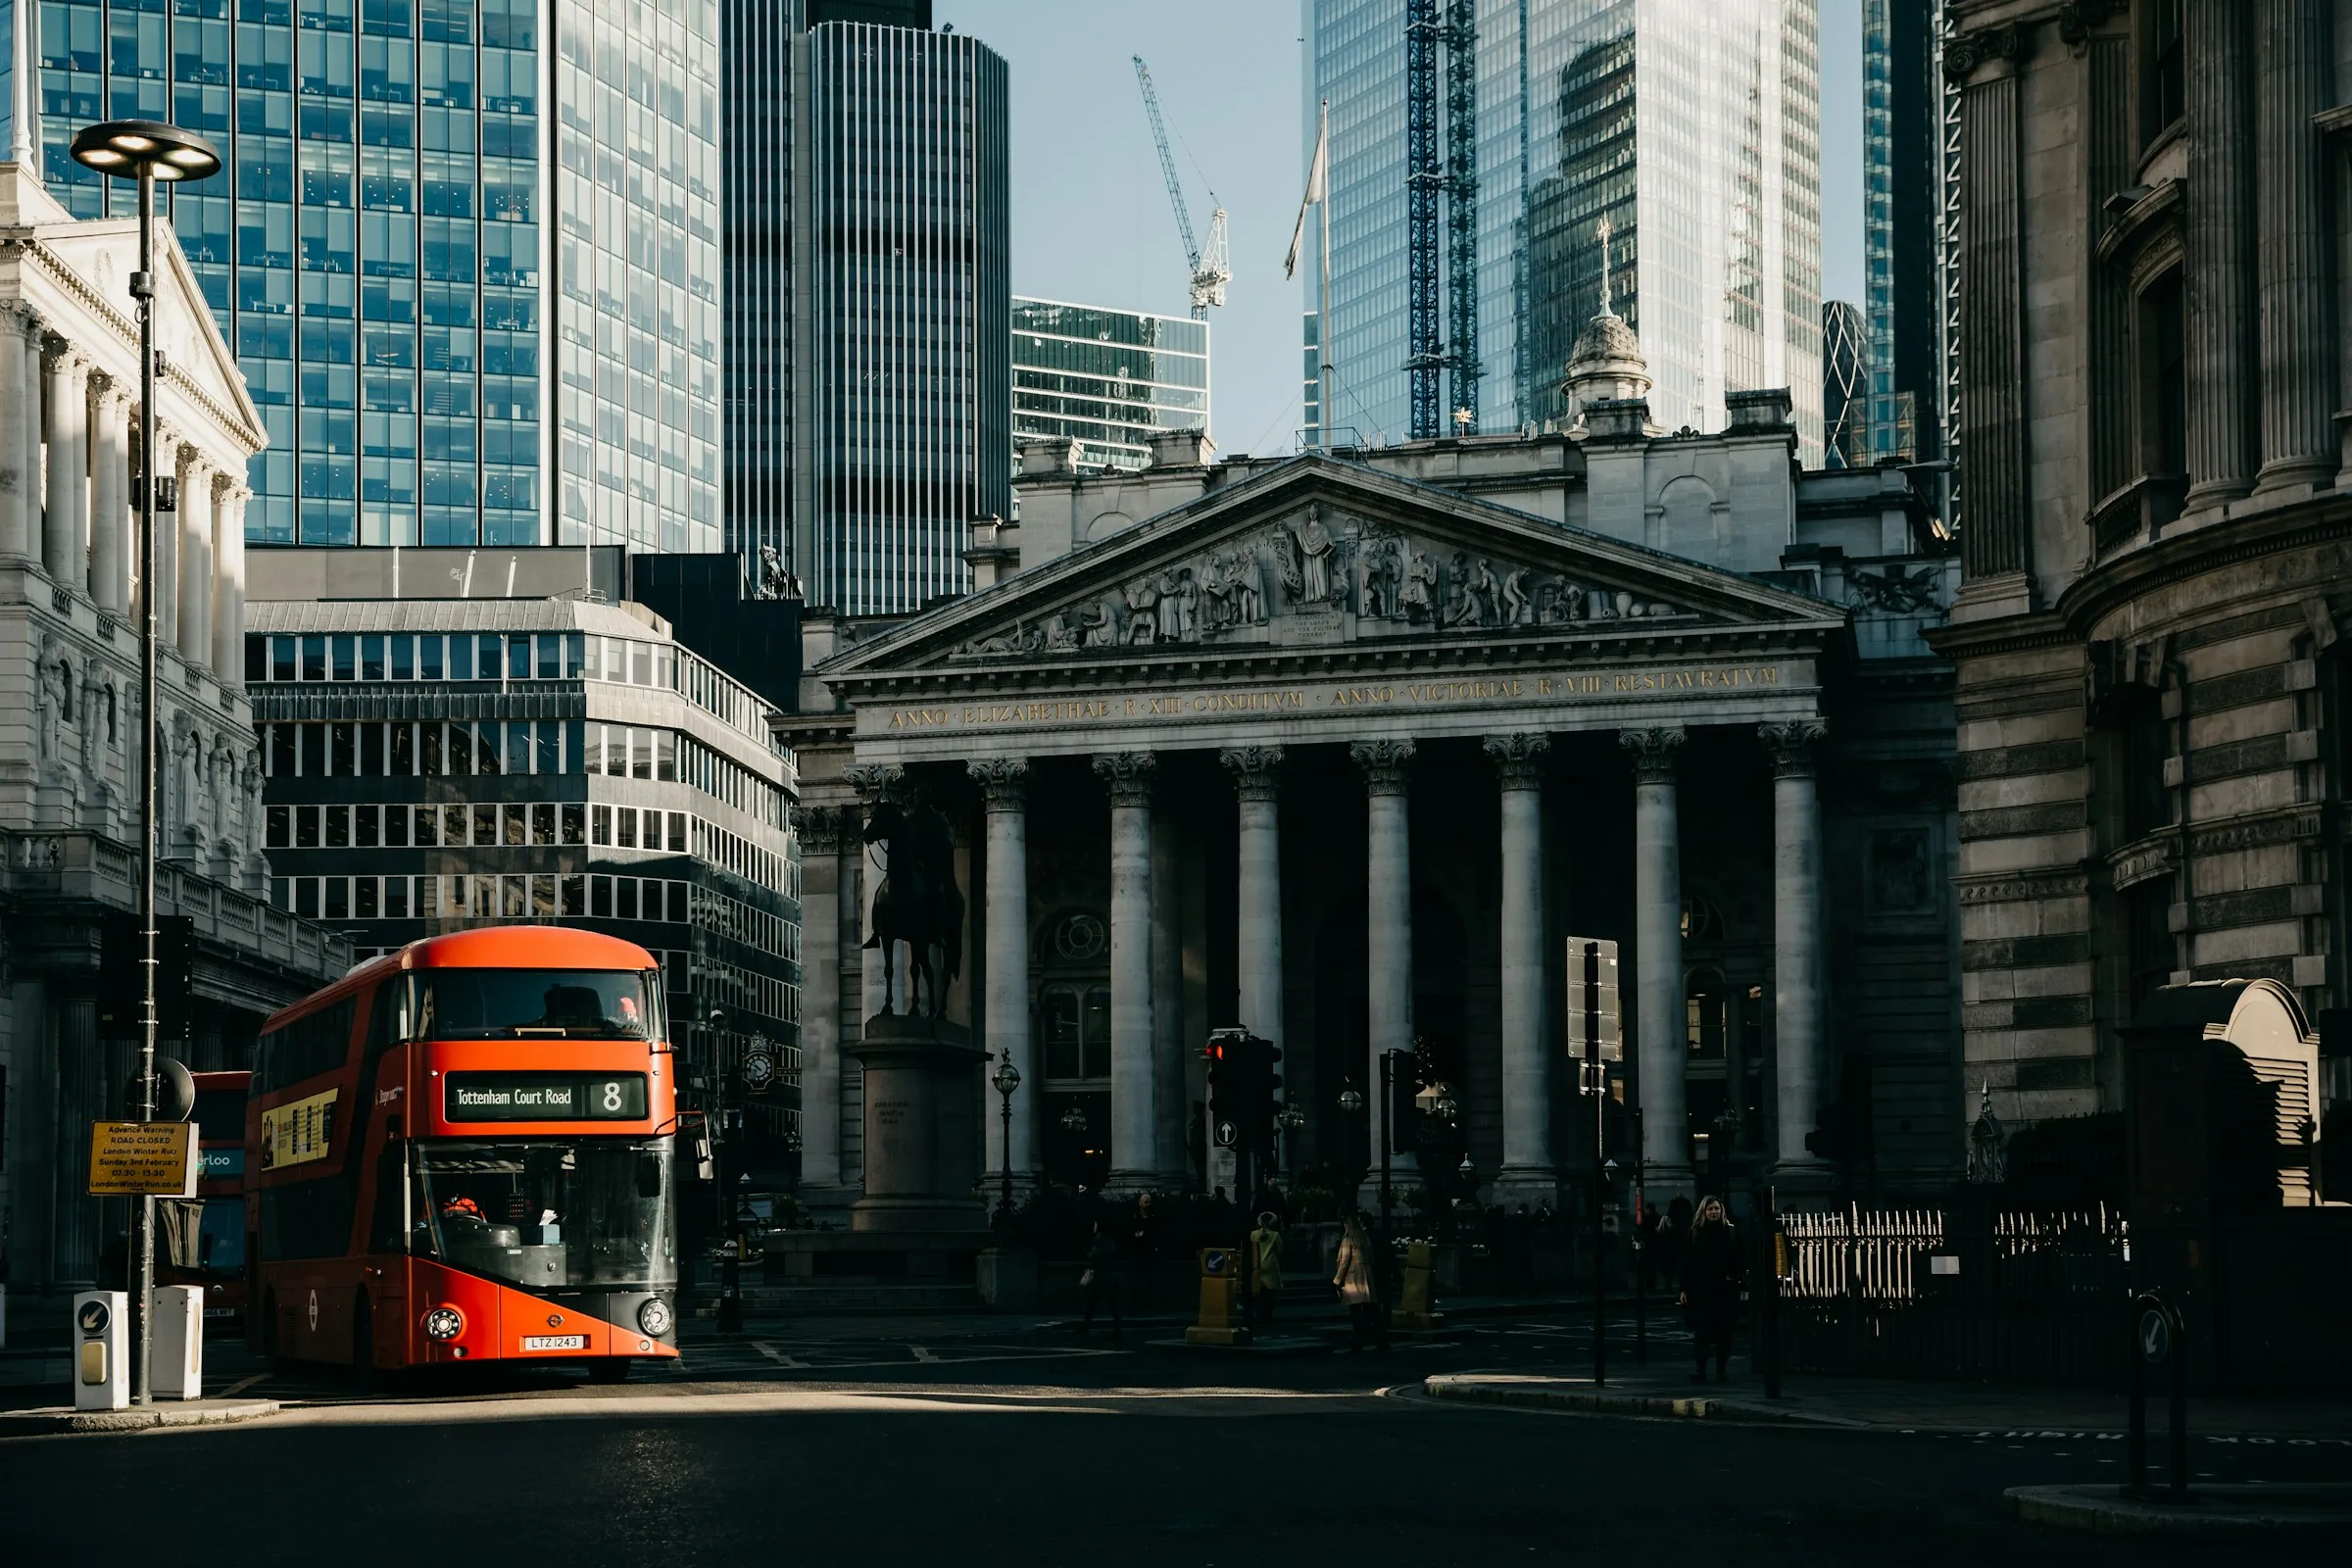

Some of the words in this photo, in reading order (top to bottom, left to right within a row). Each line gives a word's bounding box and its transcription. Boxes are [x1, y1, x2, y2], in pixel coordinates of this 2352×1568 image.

[888, 709, 949, 729] ANNO
[962, 702, 1110, 724] ELIZABETHAE
[1124, 699, 1137, 716] R
[1150, 697, 1182, 714] XIII
[1193, 691, 1304, 712] CONDITVM
[1331, 686, 1395, 706] ANNO
[1407, 679, 1526, 702] VICTORIAE
[1538, 679, 1552, 695] R
[1567, 675, 1600, 693] VIII
[1613, 666, 1779, 692] RESTAVRATVM
[456, 1088, 511, 1105] Tottenham
[514, 1089, 542, 1105] Court
[545, 1088, 572, 1104] Road
[603, 1082, 622, 1111] 8
[143, 1126, 174, 1135] Warning
